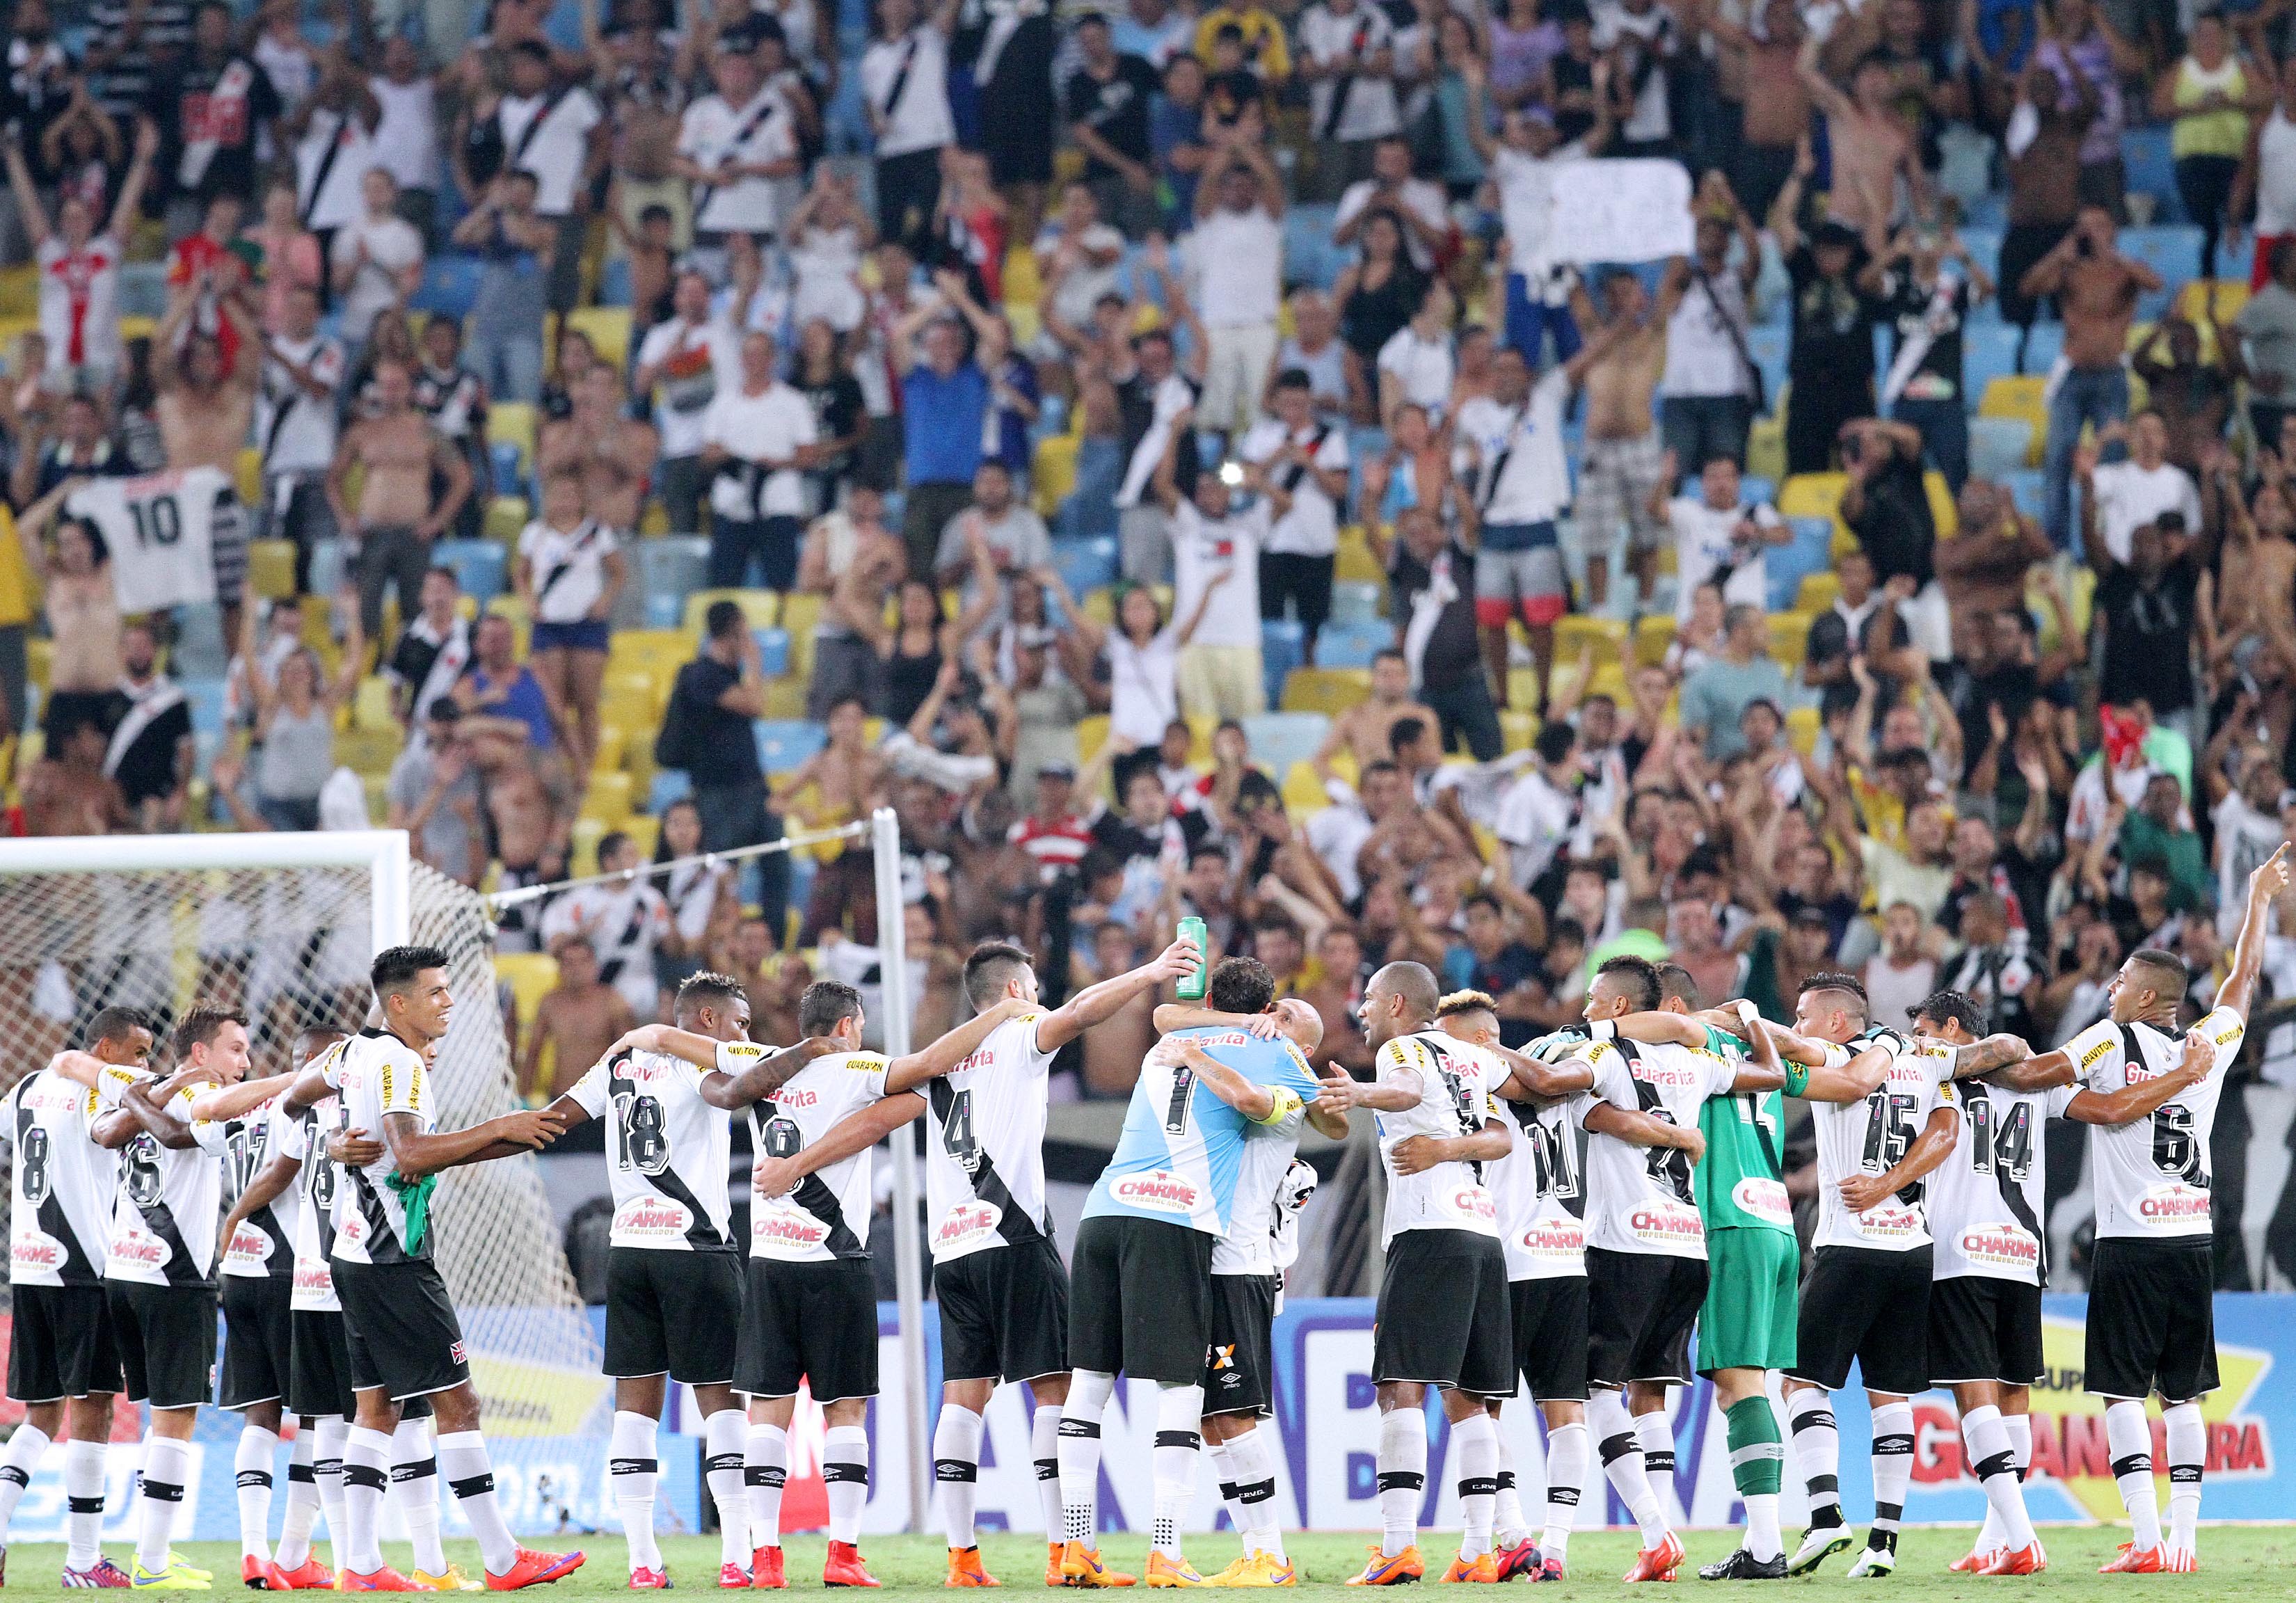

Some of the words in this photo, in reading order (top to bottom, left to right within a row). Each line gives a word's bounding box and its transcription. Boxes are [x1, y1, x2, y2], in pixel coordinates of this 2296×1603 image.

[127, 495, 181, 550] 10
[1629, 1060, 1696, 1085] Guaraita
[2081, 1038, 2115, 1069] ARAVITON
[1165, 1064, 1198, 1136] 1
[612, 1092, 671, 1177] 18
[781, 1122, 792, 1130] TIM
[943, 1085, 984, 1173] 4
[1860, 1092, 1919, 1176] 15
[1966, 1096, 2036, 1183] 14
[2149, 1101, 2197, 1177] 6
[22, 1124, 51, 1209] 8
[1524, 1120, 1579, 1200] 11
[1119, 1181, 1197, 1206] CHARME
[1121, 1196, 1187, 1211] SUPERMERCADOS
[1524, 1229, 1584, 1249] CHARM
[1863, 1227, 1910, 1236] SUPERMERC
[1963, 1234, 2037, 1261] CHARME
[1223, 1382, 1241, 1390] umbro
